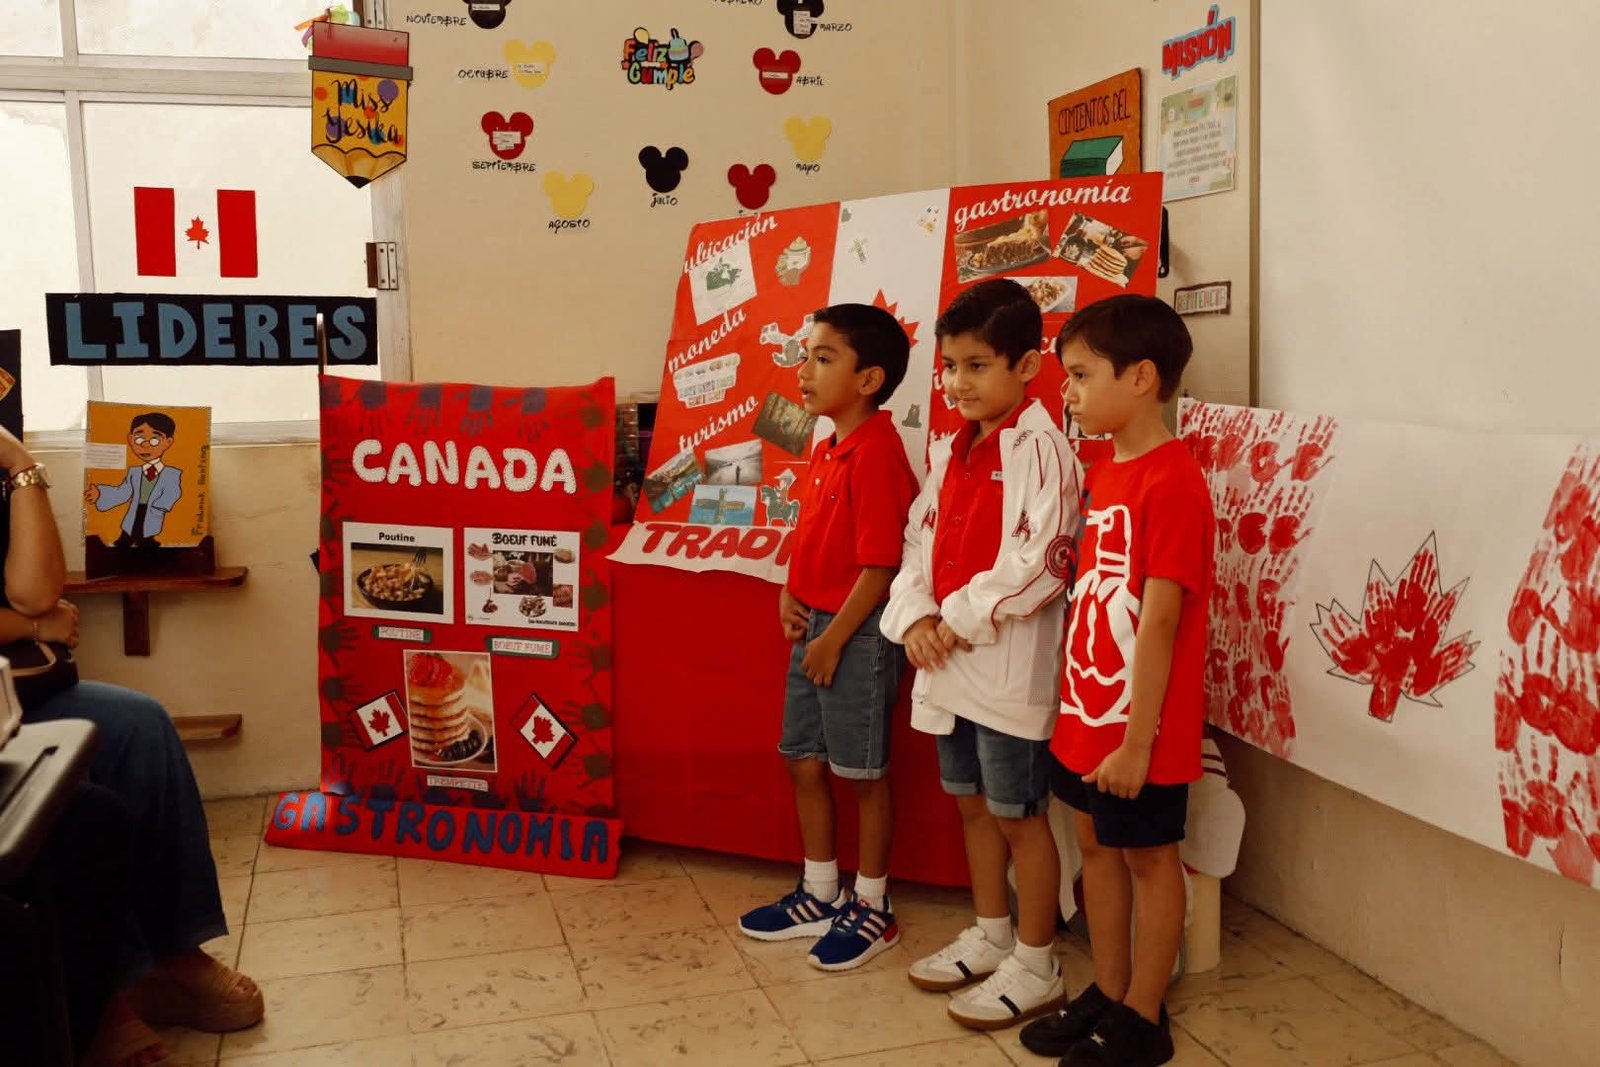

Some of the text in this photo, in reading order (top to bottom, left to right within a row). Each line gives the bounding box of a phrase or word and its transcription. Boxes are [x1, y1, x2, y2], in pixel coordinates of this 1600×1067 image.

[406, 13, 467, 27] NOVIEMBRE
[820, 23, 852, 32] MARZO
[1162, 7, 1234, 78] MISIÓN
[458, 69, 508, 81] OCTUBRE
[796, 75, 824, 86] ABRIL
[331, 79, 393, 113] Miss
[1057, 88, 1131, 136] CIMIENTOS DEL
[472, 160, 536, 174] SEPTIEMBRE
[796, 163, 820, 175] MAYO
[953, 178, 1132, 233] gastronomía
[548, 219, 590, 234] AGOSTO
[683, 213, 778, 274] ubicación
[65, 302, 367, 360] LIDERES
[668, 307, 747, 374] moneda
[679, 395, 759, 453] turismo
[352, 439, 577, 494] CANADA
[379, 531, 415, 543] Poutine
[492, 532, 557, 547] BOEUF FUMÉ
[273, 791, 610, 864] GASTRONOMIA
